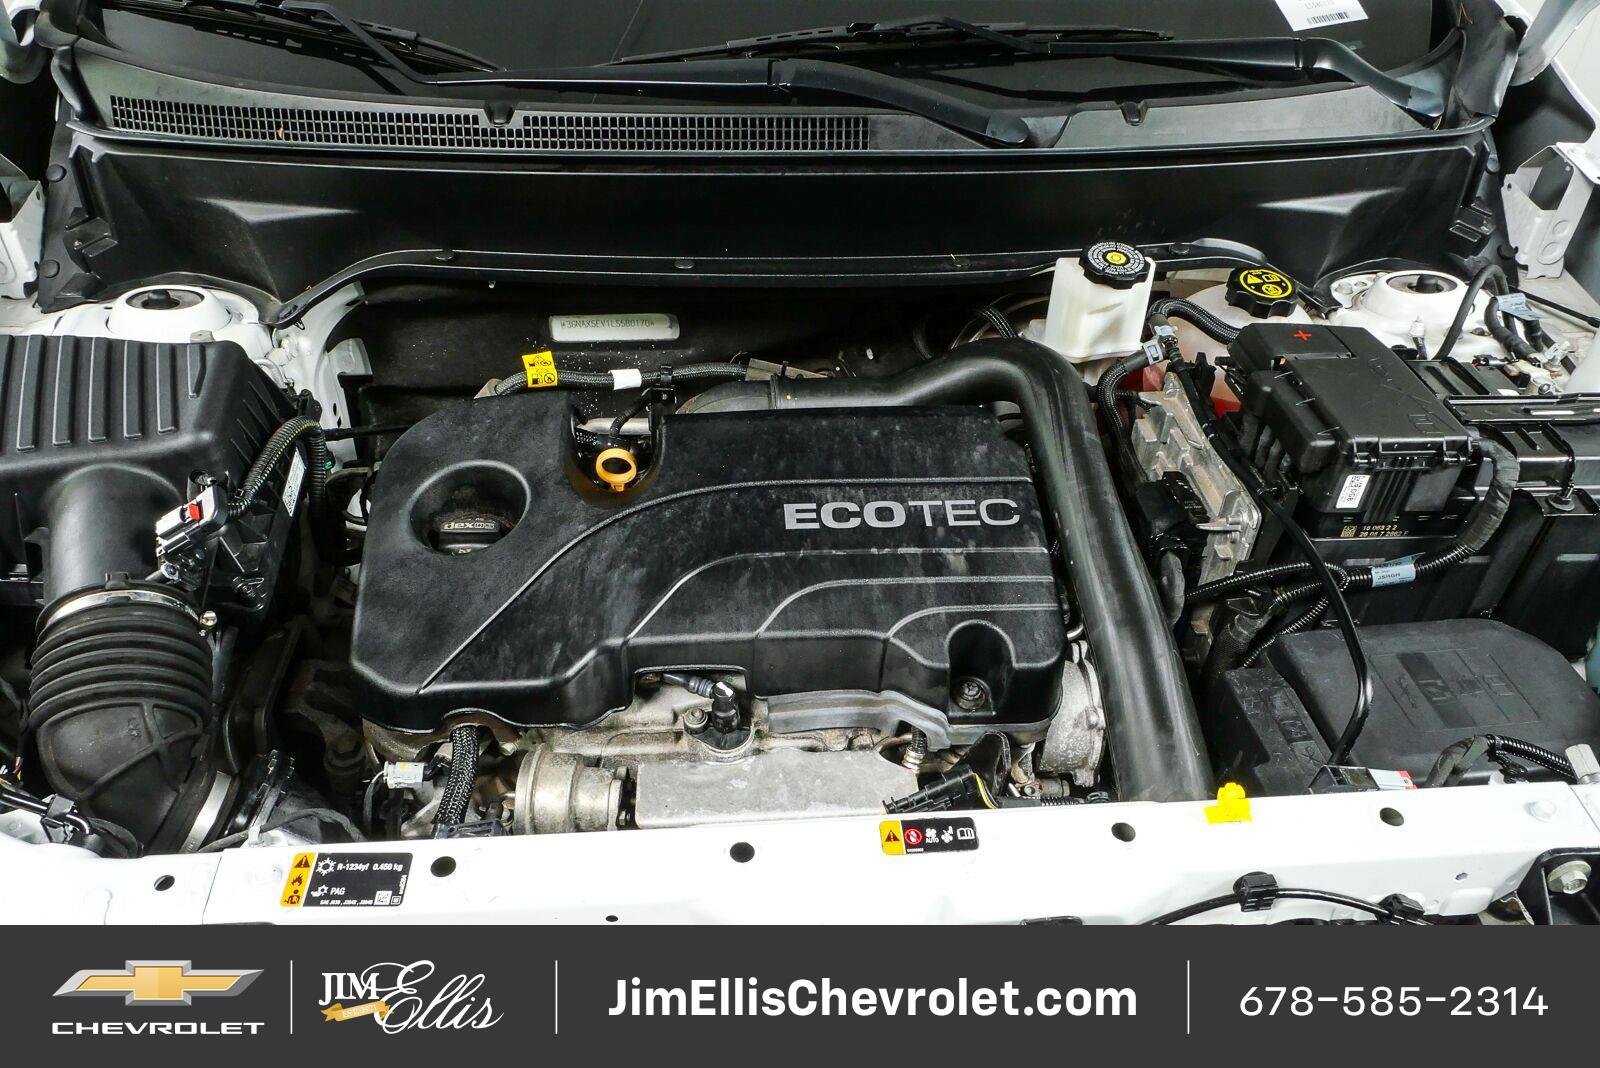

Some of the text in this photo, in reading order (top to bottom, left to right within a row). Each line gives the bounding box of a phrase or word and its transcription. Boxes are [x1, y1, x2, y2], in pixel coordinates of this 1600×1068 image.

[784, 498, 1019, 529] ECOTEC
[336, 862, 370, 872] R-1234yf
[329, 887, 346, 895] PAG
